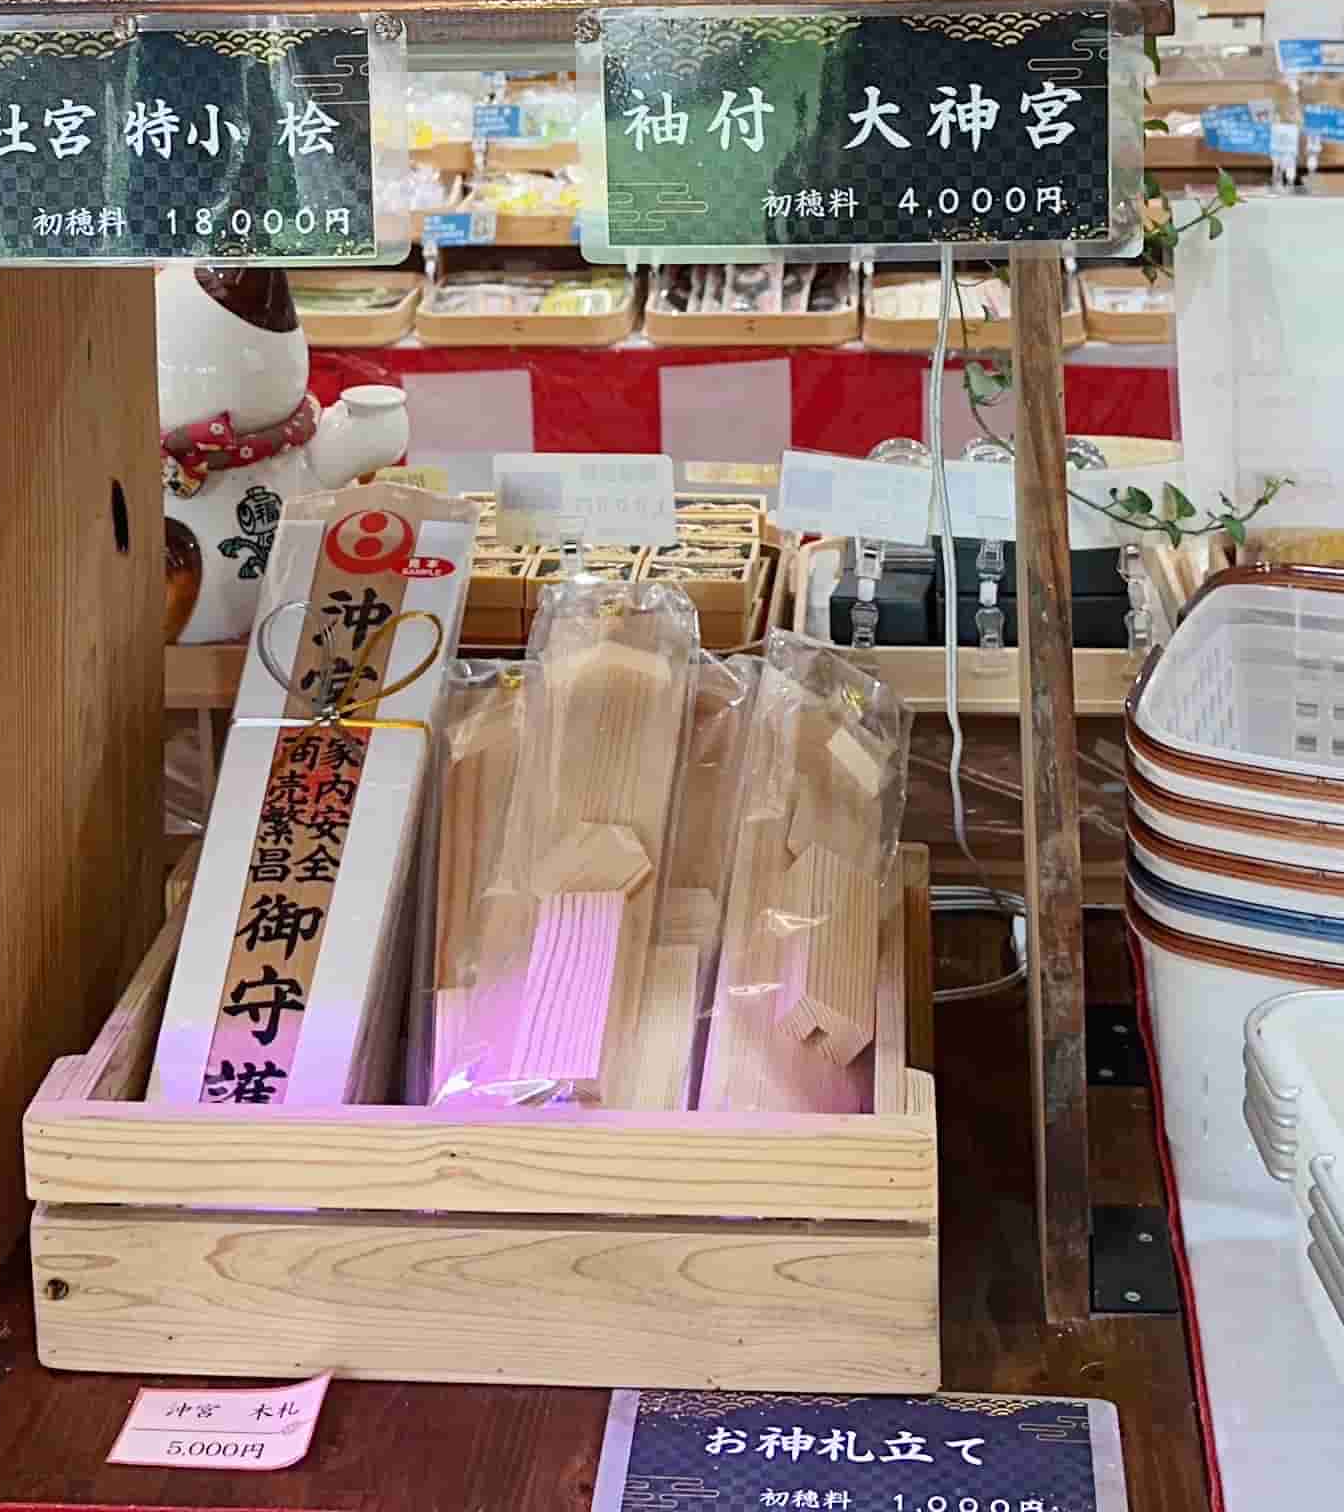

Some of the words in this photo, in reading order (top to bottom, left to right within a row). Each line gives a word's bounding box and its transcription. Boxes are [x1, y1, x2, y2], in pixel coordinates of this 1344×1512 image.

[122, 98, 242, 161] 特小
[276, 98, 342, 157] 桧
[622, 86, 776, 154] 袖付
[841, 81, 1084, 153] 大神宮
[32, 207, 128, 238] 初穂料
[164, 206, 352, 240] 18,000円
[760, 187, 860, 220] 初穂料
[897, 185, 1066, 220] 4,000円
[294, 736, 365, 884] 家内安全
[703, 1425, 987, 1466] お神札立て
[758, 1486, 854, 1512] 初穂料
